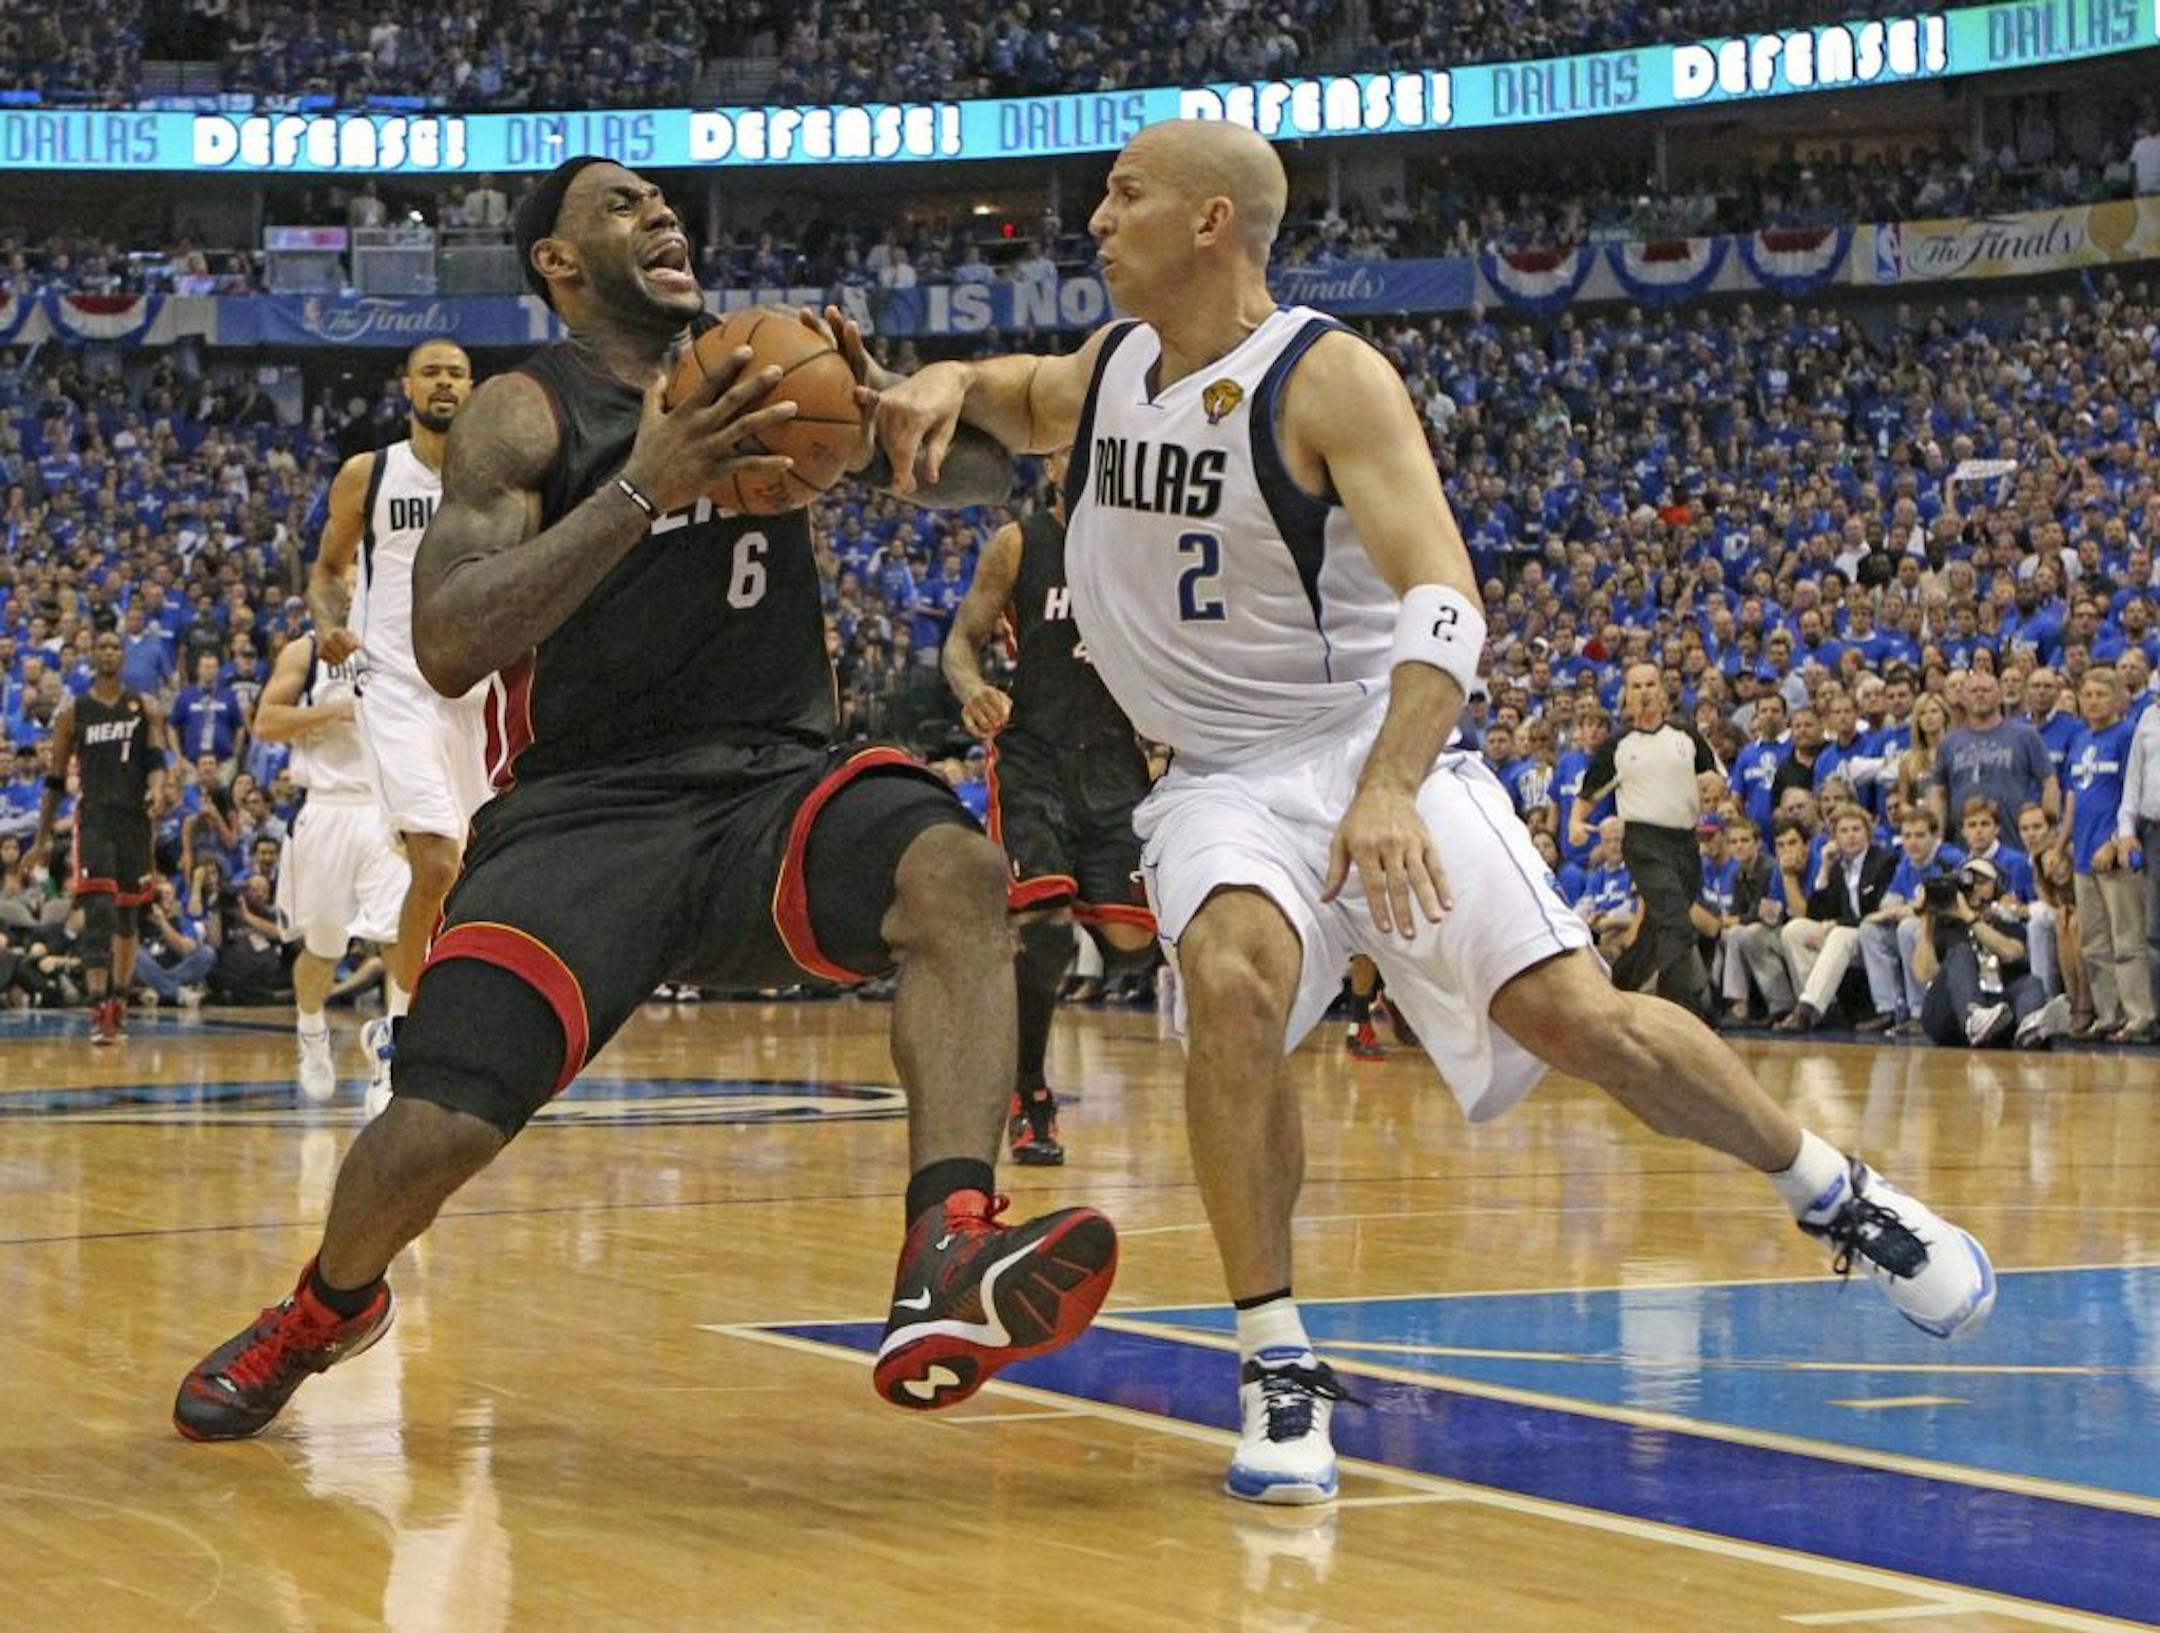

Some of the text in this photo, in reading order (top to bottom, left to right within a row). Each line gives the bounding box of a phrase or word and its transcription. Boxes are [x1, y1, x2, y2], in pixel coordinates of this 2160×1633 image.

[4, 114, 158, 164] DALLAS
[193, 114, 467, 169] DEFENSE!
[507, 114, 656, 165] DALLAS
[689, 105, 962, 161] DEFENSE!
[1000, 95, 1146, 151] DALLAS
[1492, 54, 1640, 118] DALLAS
[1673, 14, 1949, 102] DEFENSE!
[1988, 0, 2138, 62] DALLAS
[1956, 215, 2084, 270] Finals
[1281, 266, 1385, 301] Finals
[354, 297, 460, 335] Finals
[928, 276, 1106, 333] IS NO
[390, 496, 434, 531] DAL
[726, 531, 769, 609] 6
[1176, 531, 1226, 622] 2
[1432, 605, 1458, 642] 2
[86, 716, 141, 744] HEAT
[121, 740, 131, 763] 1
